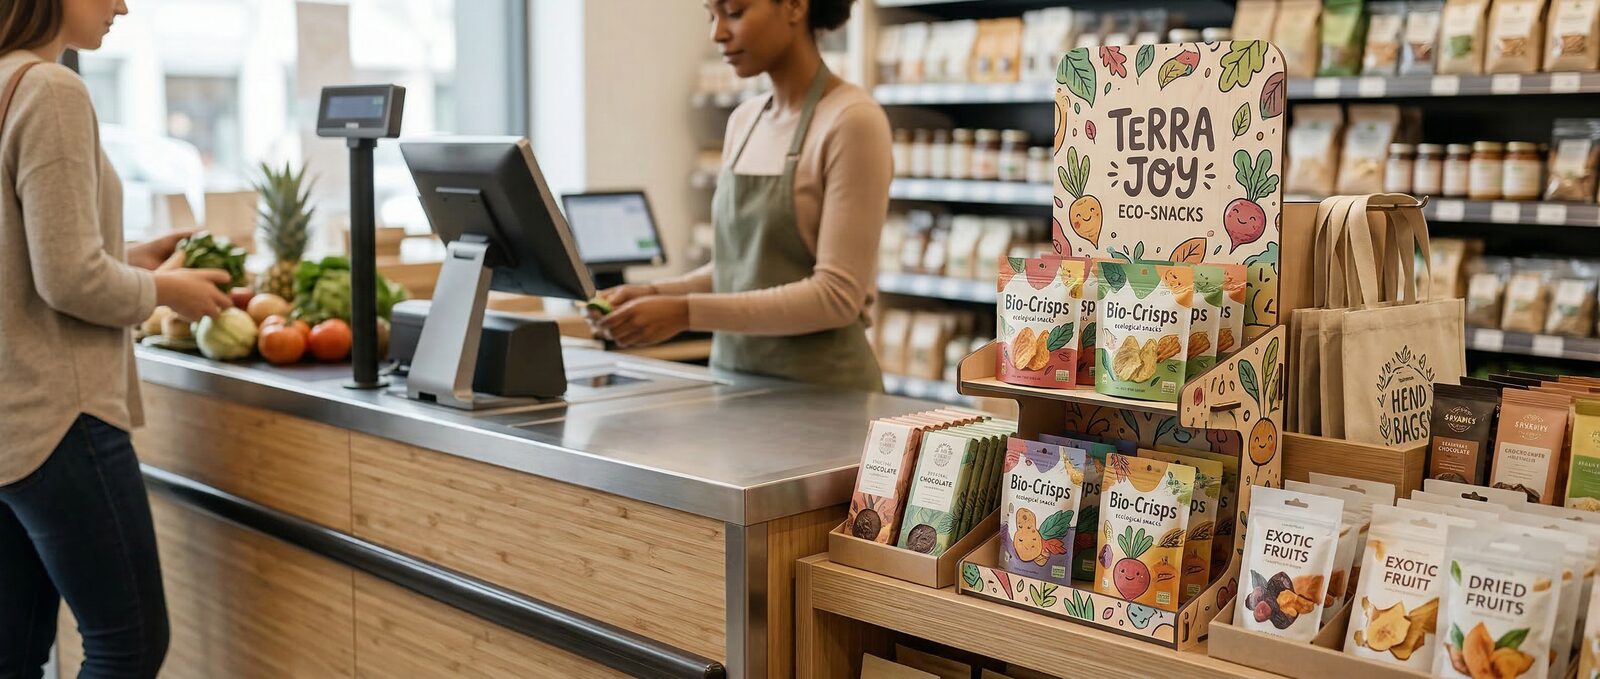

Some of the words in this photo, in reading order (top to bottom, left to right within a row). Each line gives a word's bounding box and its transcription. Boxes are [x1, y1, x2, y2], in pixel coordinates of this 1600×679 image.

[1107, 106, 1215, 152] TERRA
[1123, 156, 1198, 199] JOY
[1118, 204, 1204, 222] ECO-SNACKS
[1005, 293, 1070, 318] Bio-Crisps
[1106, 301, 1178, 327] Bio-Crisps
[1391, 384, 1427, 414] HEND
[865, 463, 897, 475] CHOCOLATE
[919, 475, 953, 488] CHOCOLATE
[1010, 473, 1072, 501] Bio-Crisps
[1109, 490, 1178, 521] Bio-Crisps
[1265, 529, 1314, 549] EXOTIC
[1263, 543, 1309, 563] FRUITS
[1385, 555, 1439, 577] EXOTIC
[1469, 575, 1527, 598] DRIED
[1466, 592, 1525, 616] FRUITS
